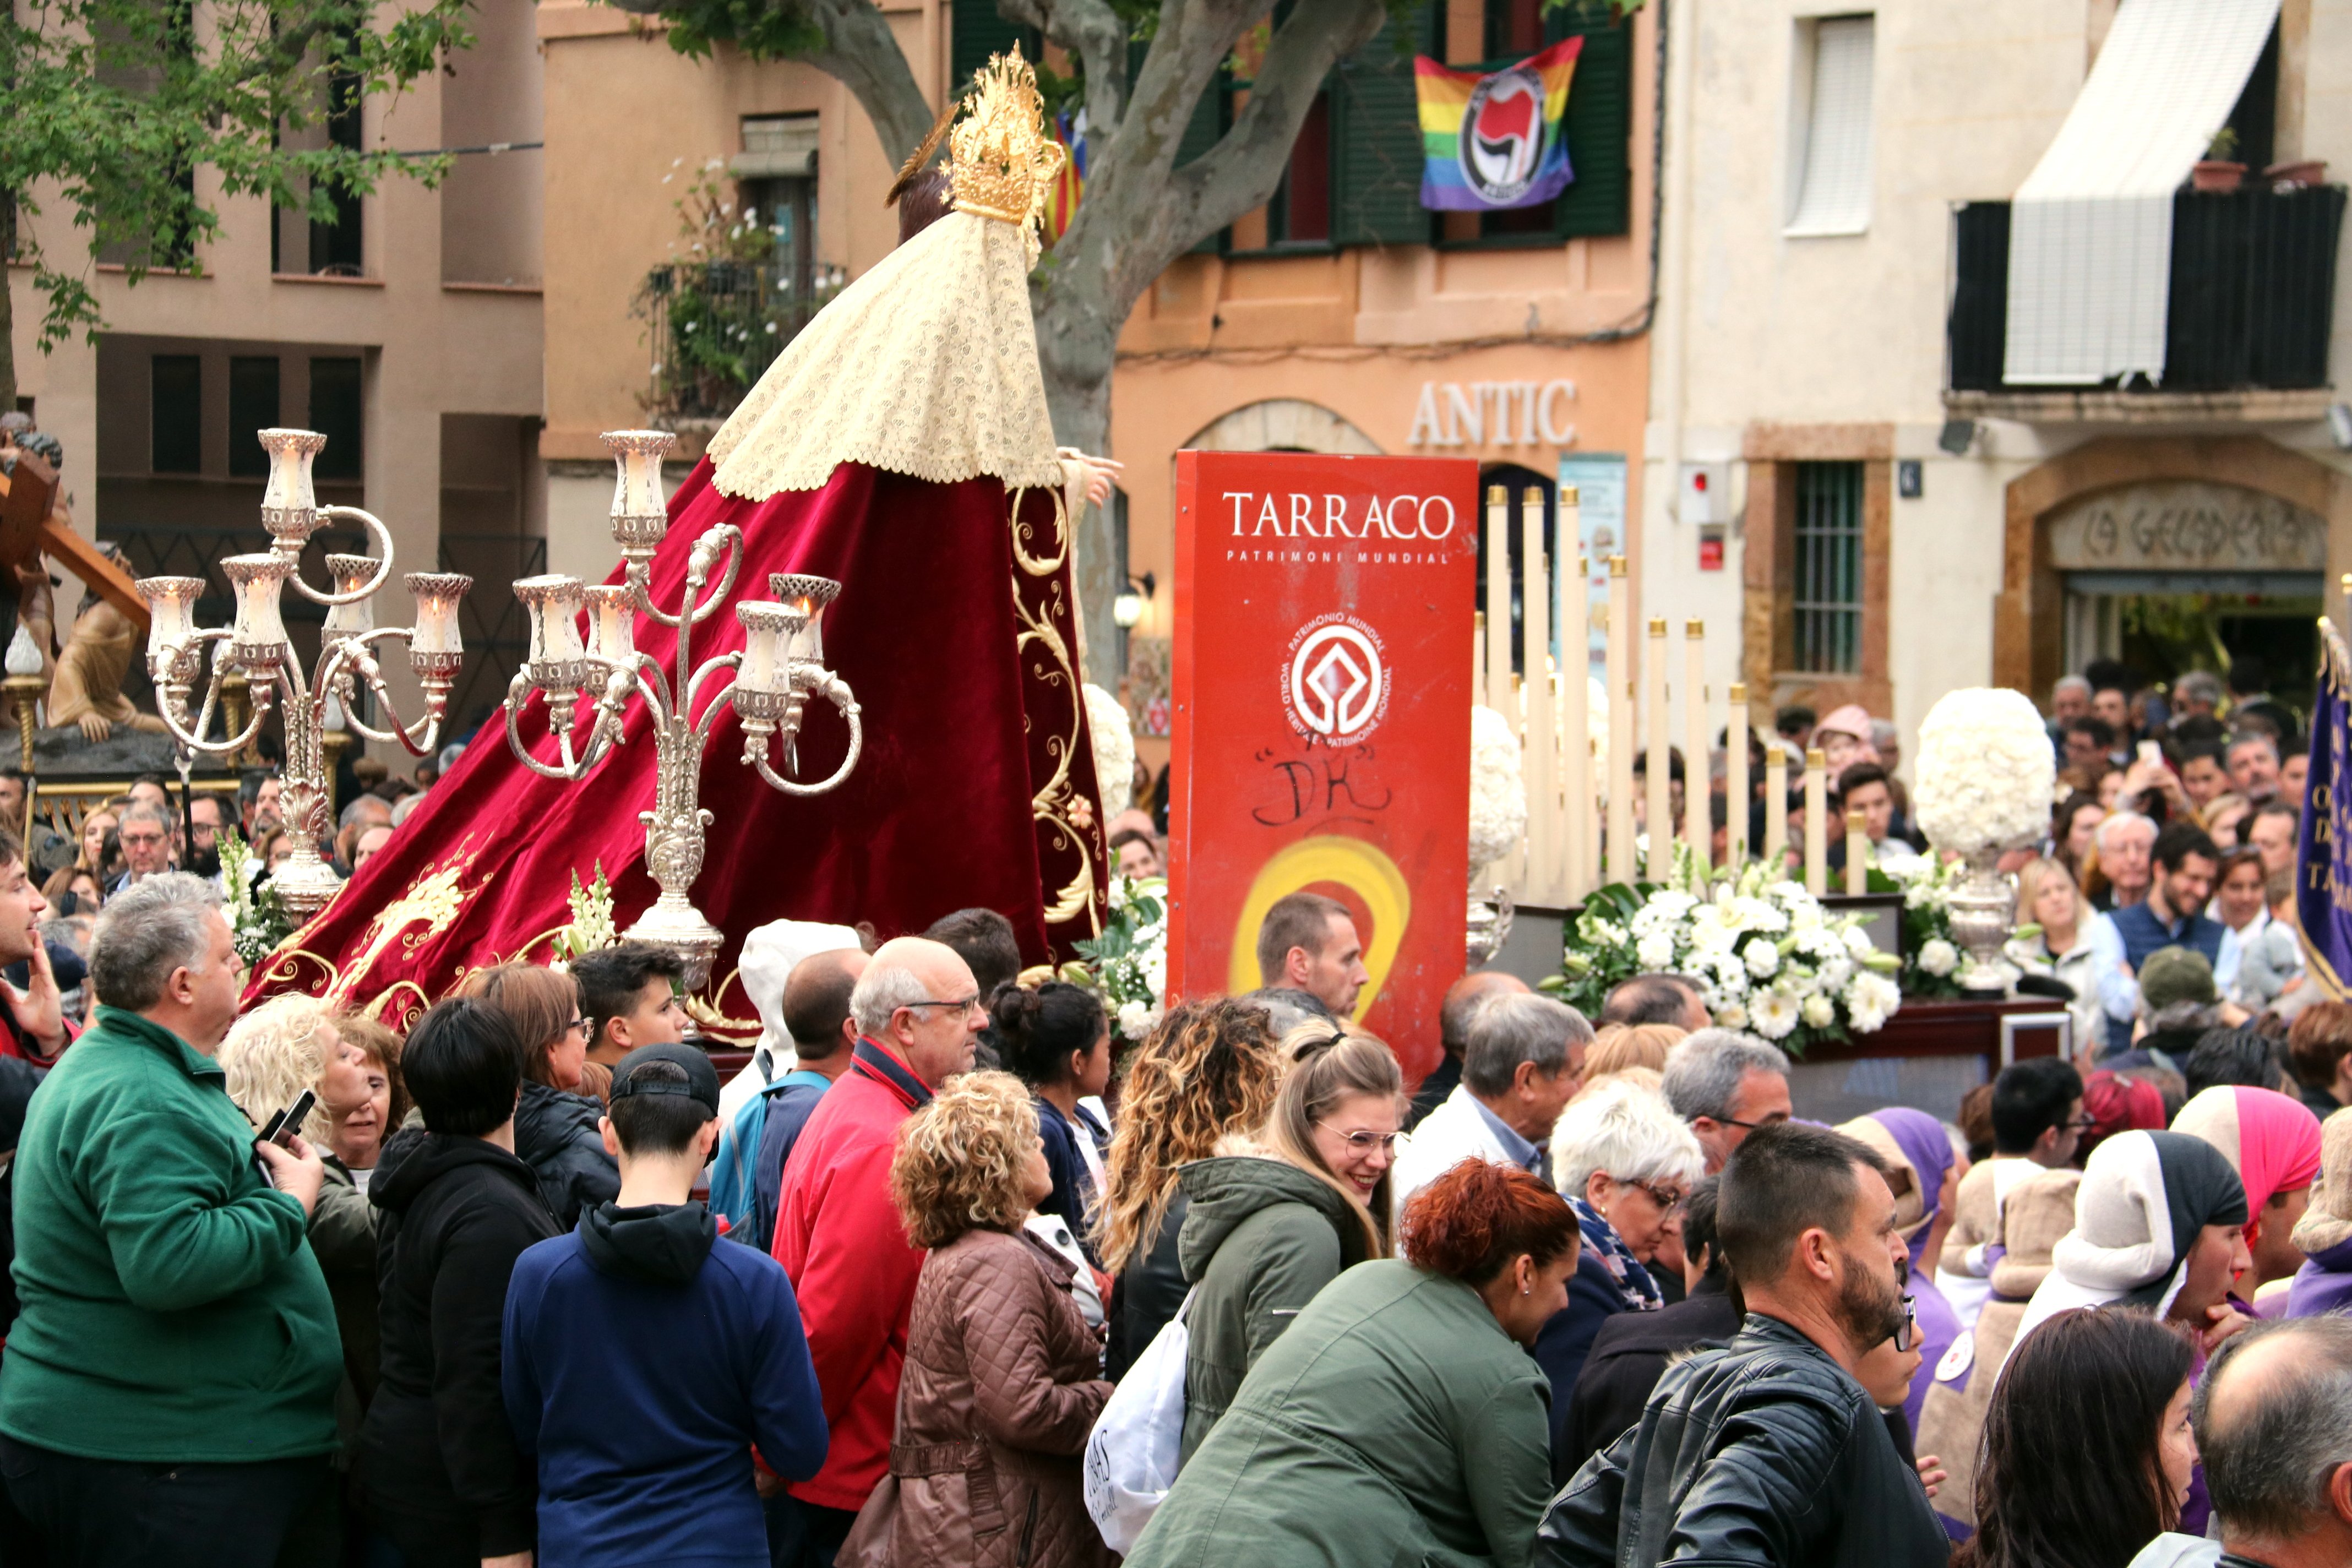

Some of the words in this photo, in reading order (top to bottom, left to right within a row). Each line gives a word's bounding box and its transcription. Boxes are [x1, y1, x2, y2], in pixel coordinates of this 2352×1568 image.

[1406, 378, 1579, 447] ANTIC
[1222, 492, 1455, 540] TARRACO
[1227, 551, 1341, 563] PATRIMONI
[1358, 553, 1448, 564] MUNDIAL
[1288, 612, 1345, 651] PATRIMONIO
[1347, 615, 1386, 653] MUNDIAL
[1280, 662, 1291, 704] WORLD
[1284, 705, 1319, 745] HERITAE
[1327, 718, 1379, 748] PATRIMOINE
[1375, 666, 1392, 720] MONDIAL
